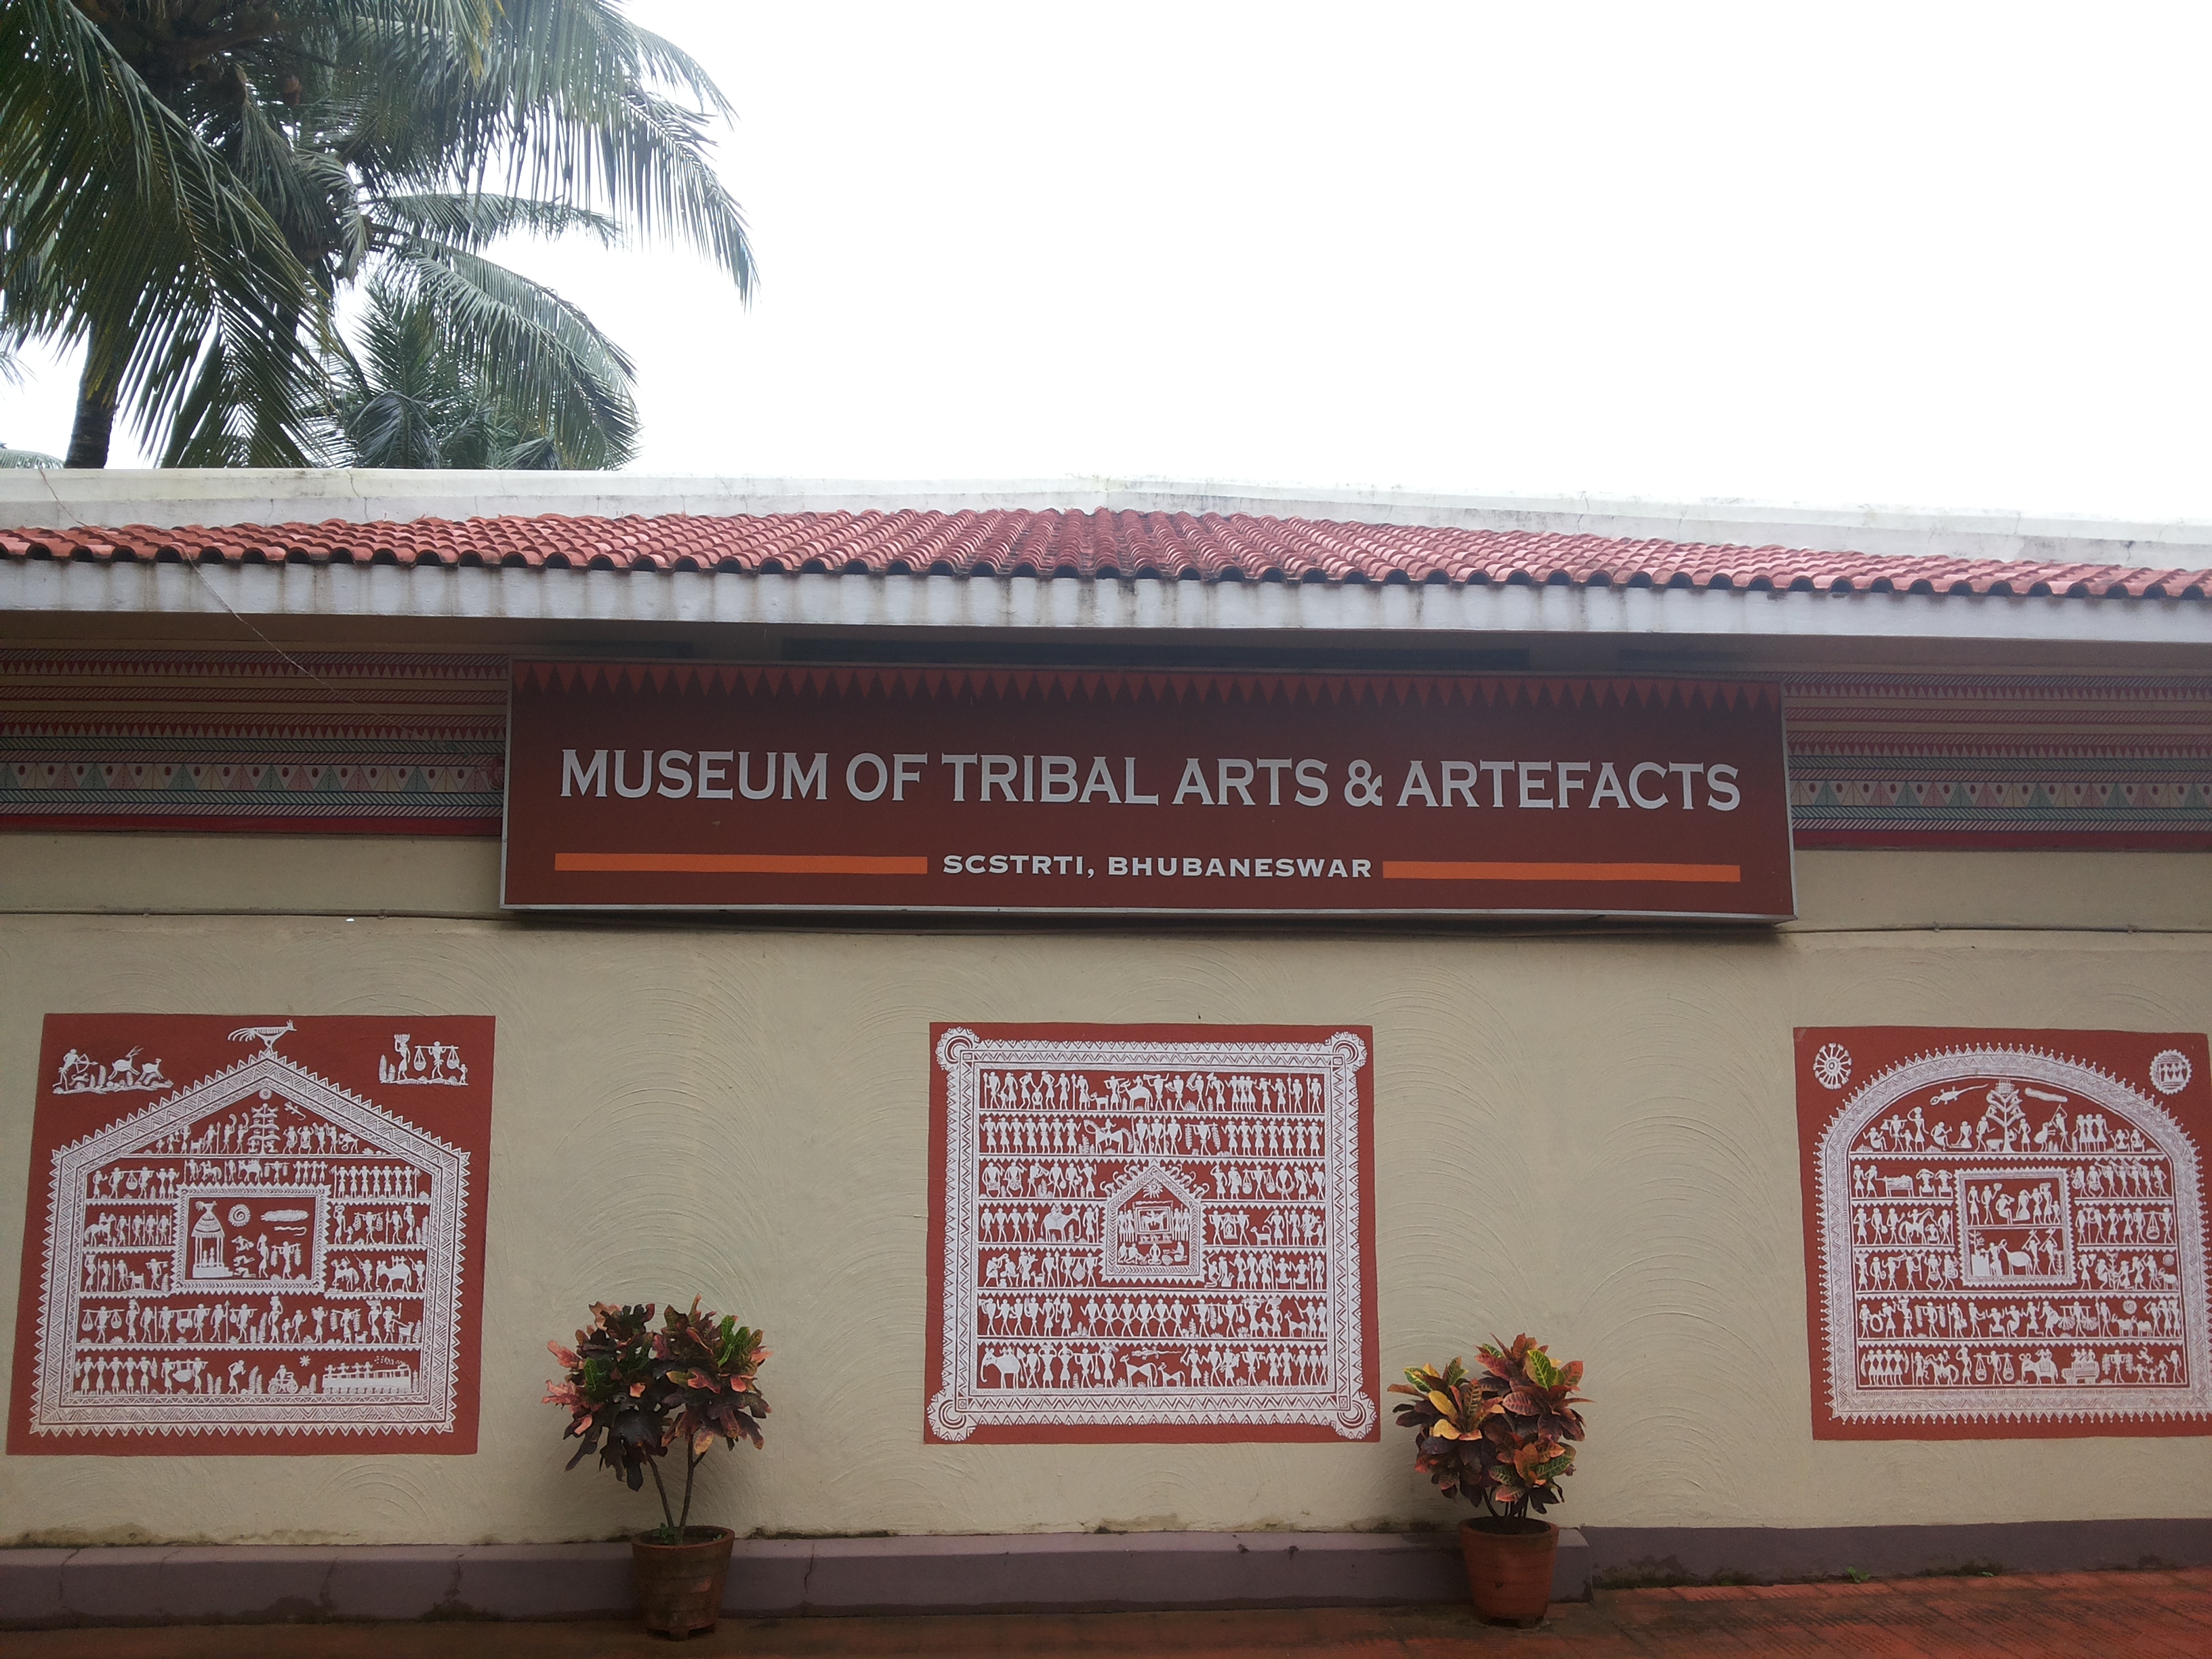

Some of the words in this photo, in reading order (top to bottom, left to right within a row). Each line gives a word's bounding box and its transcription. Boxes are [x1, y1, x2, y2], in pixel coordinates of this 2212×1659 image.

[560, 749, 828, 800] MUSEUM
[846, 752, 928, 801] OF
[941, 752, 1159, 806] TRIBAL
[1171, 757, 1329, 806] ARTS
[1344, 759, 1383, 807] &
[1396, 759, 1740, 811] ARTEFACTS
[943, 855, 1094, 879] SCSTRTI,
[1108, 857, 1372, 878] BHUBANESWAR
